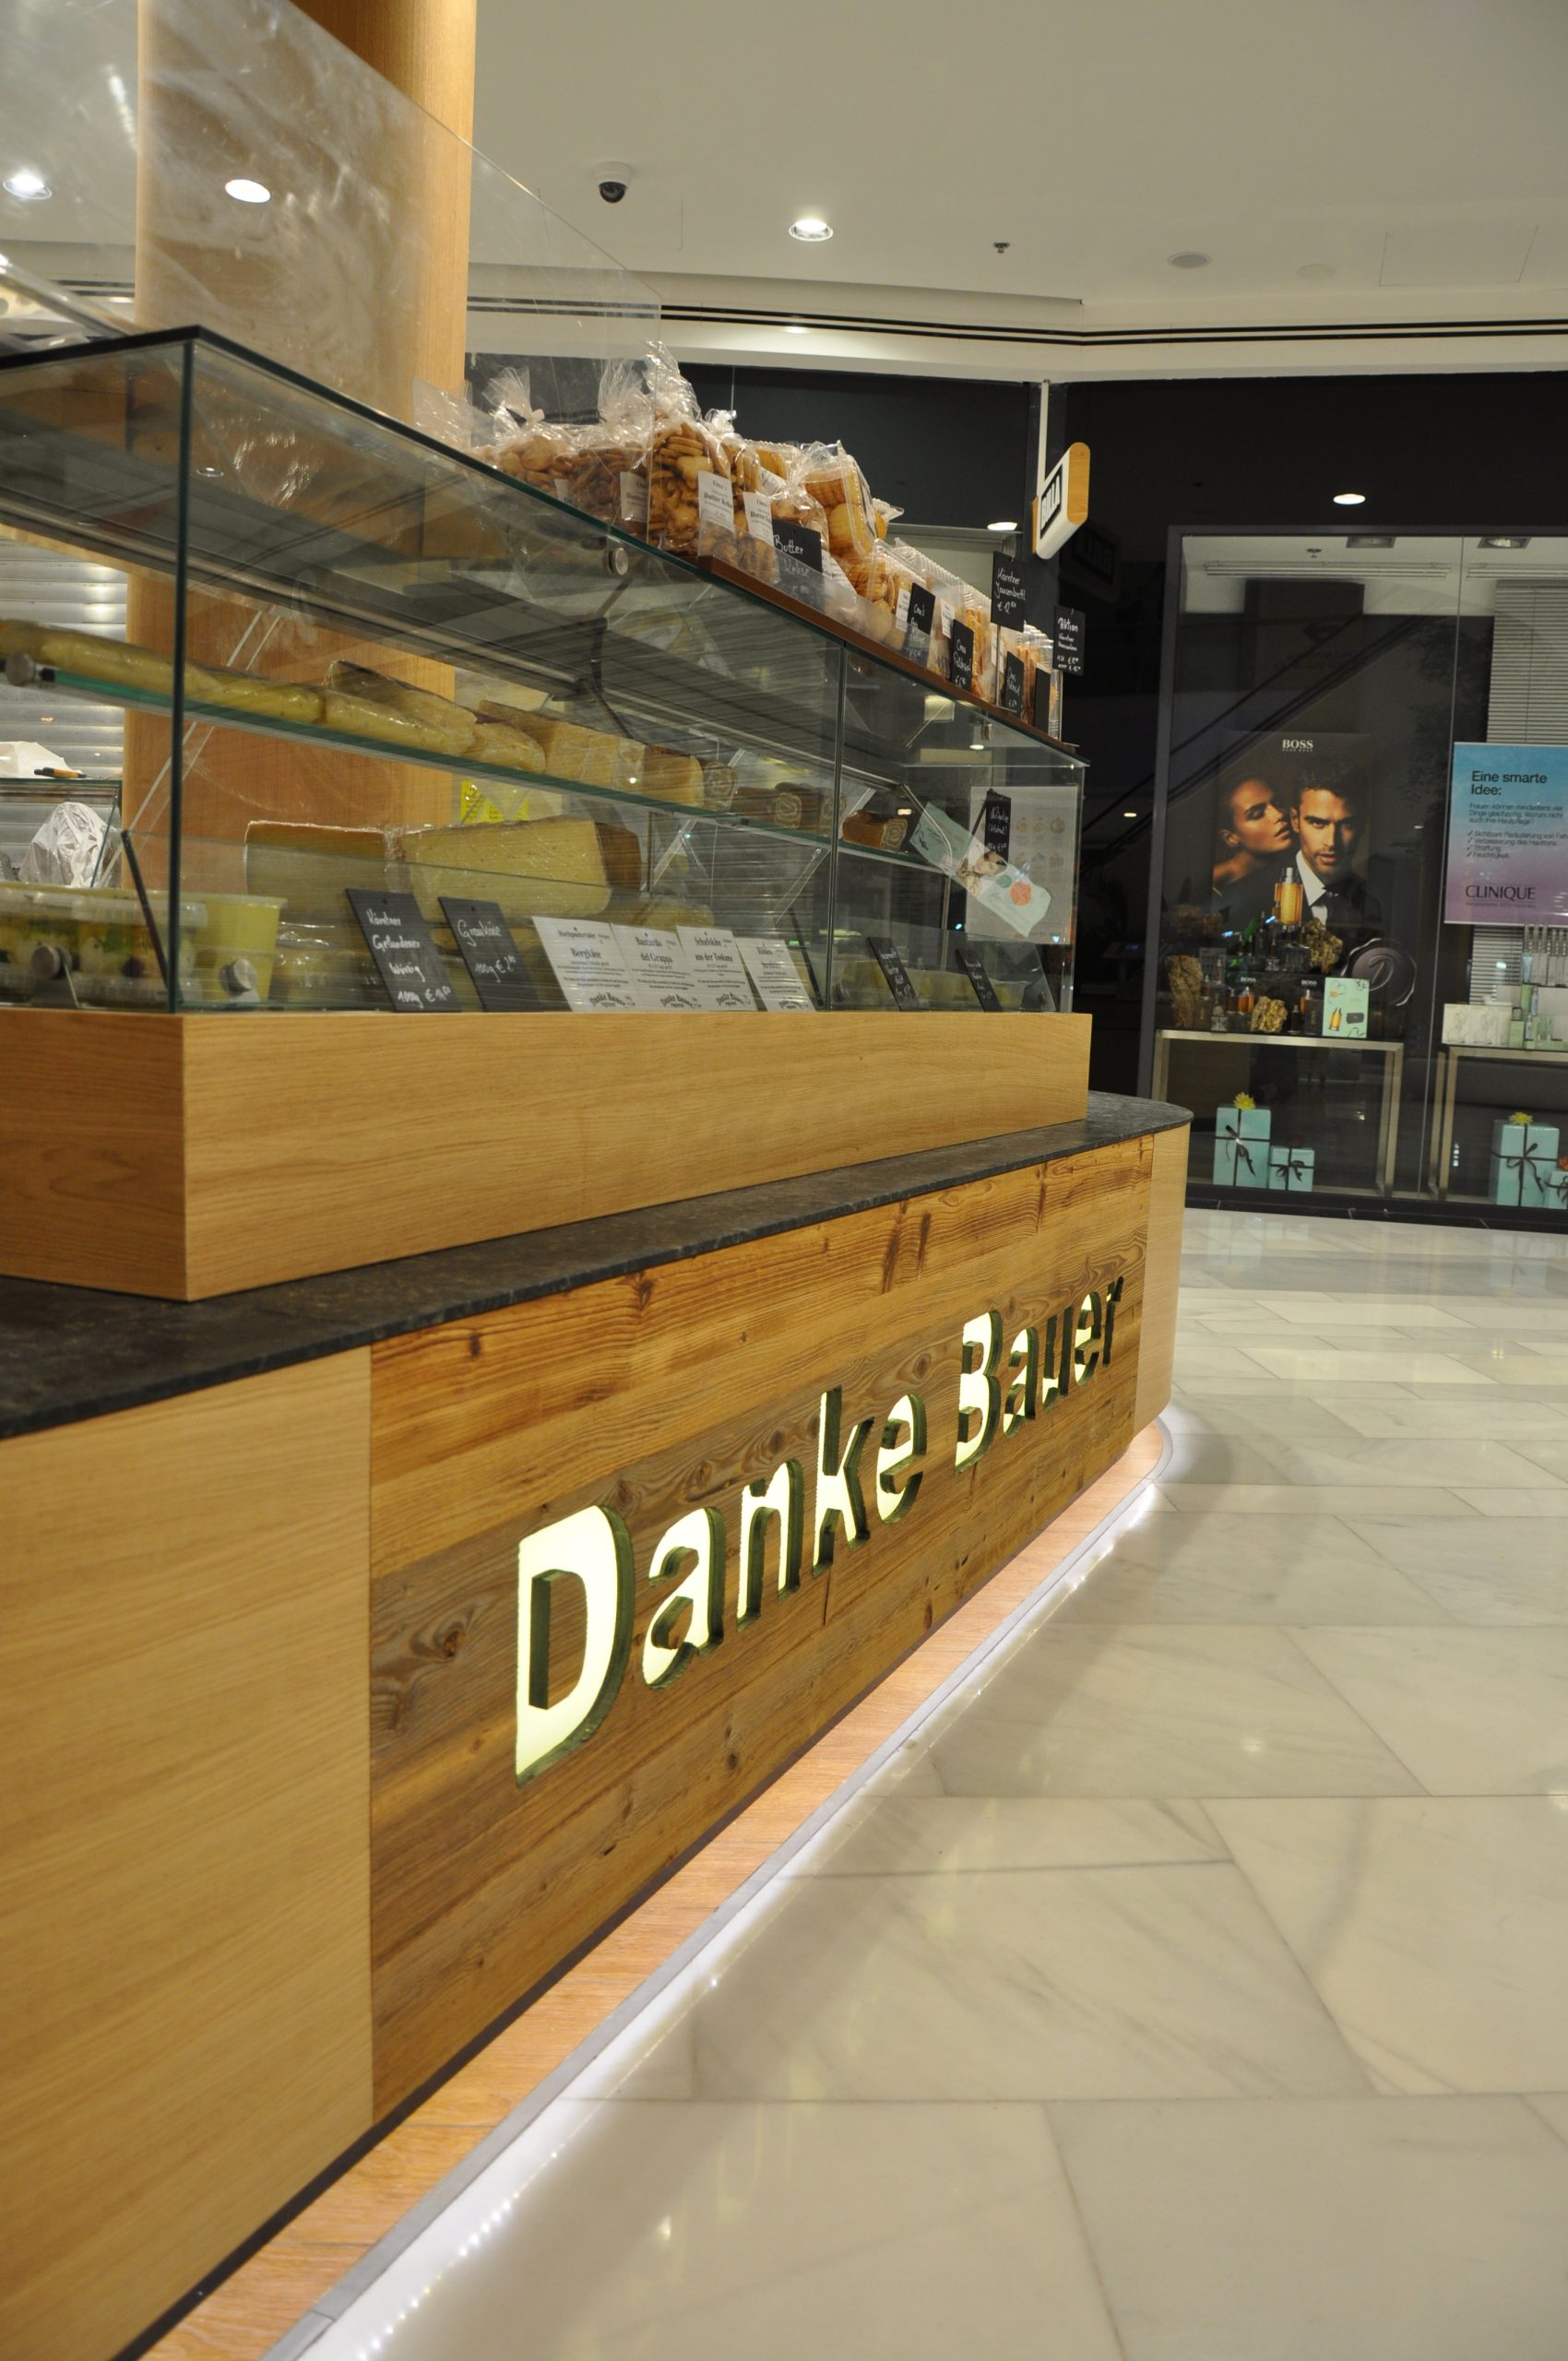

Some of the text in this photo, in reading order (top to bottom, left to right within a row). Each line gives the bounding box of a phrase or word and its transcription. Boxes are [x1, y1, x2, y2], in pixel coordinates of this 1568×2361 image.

[773, 534, 804, 555] Butter
[1057, 617, 1079, 633] Aktion
[1282, 739, 1313, 750] BOSS
[1471, 770, 1548, 784] Eine smarte
[1470, 784, 1502, 796] Idee:
[1465, 884, 1537, 902] CLINIQUE
[515, 1275, 1124, 1787] Danke Bauer
